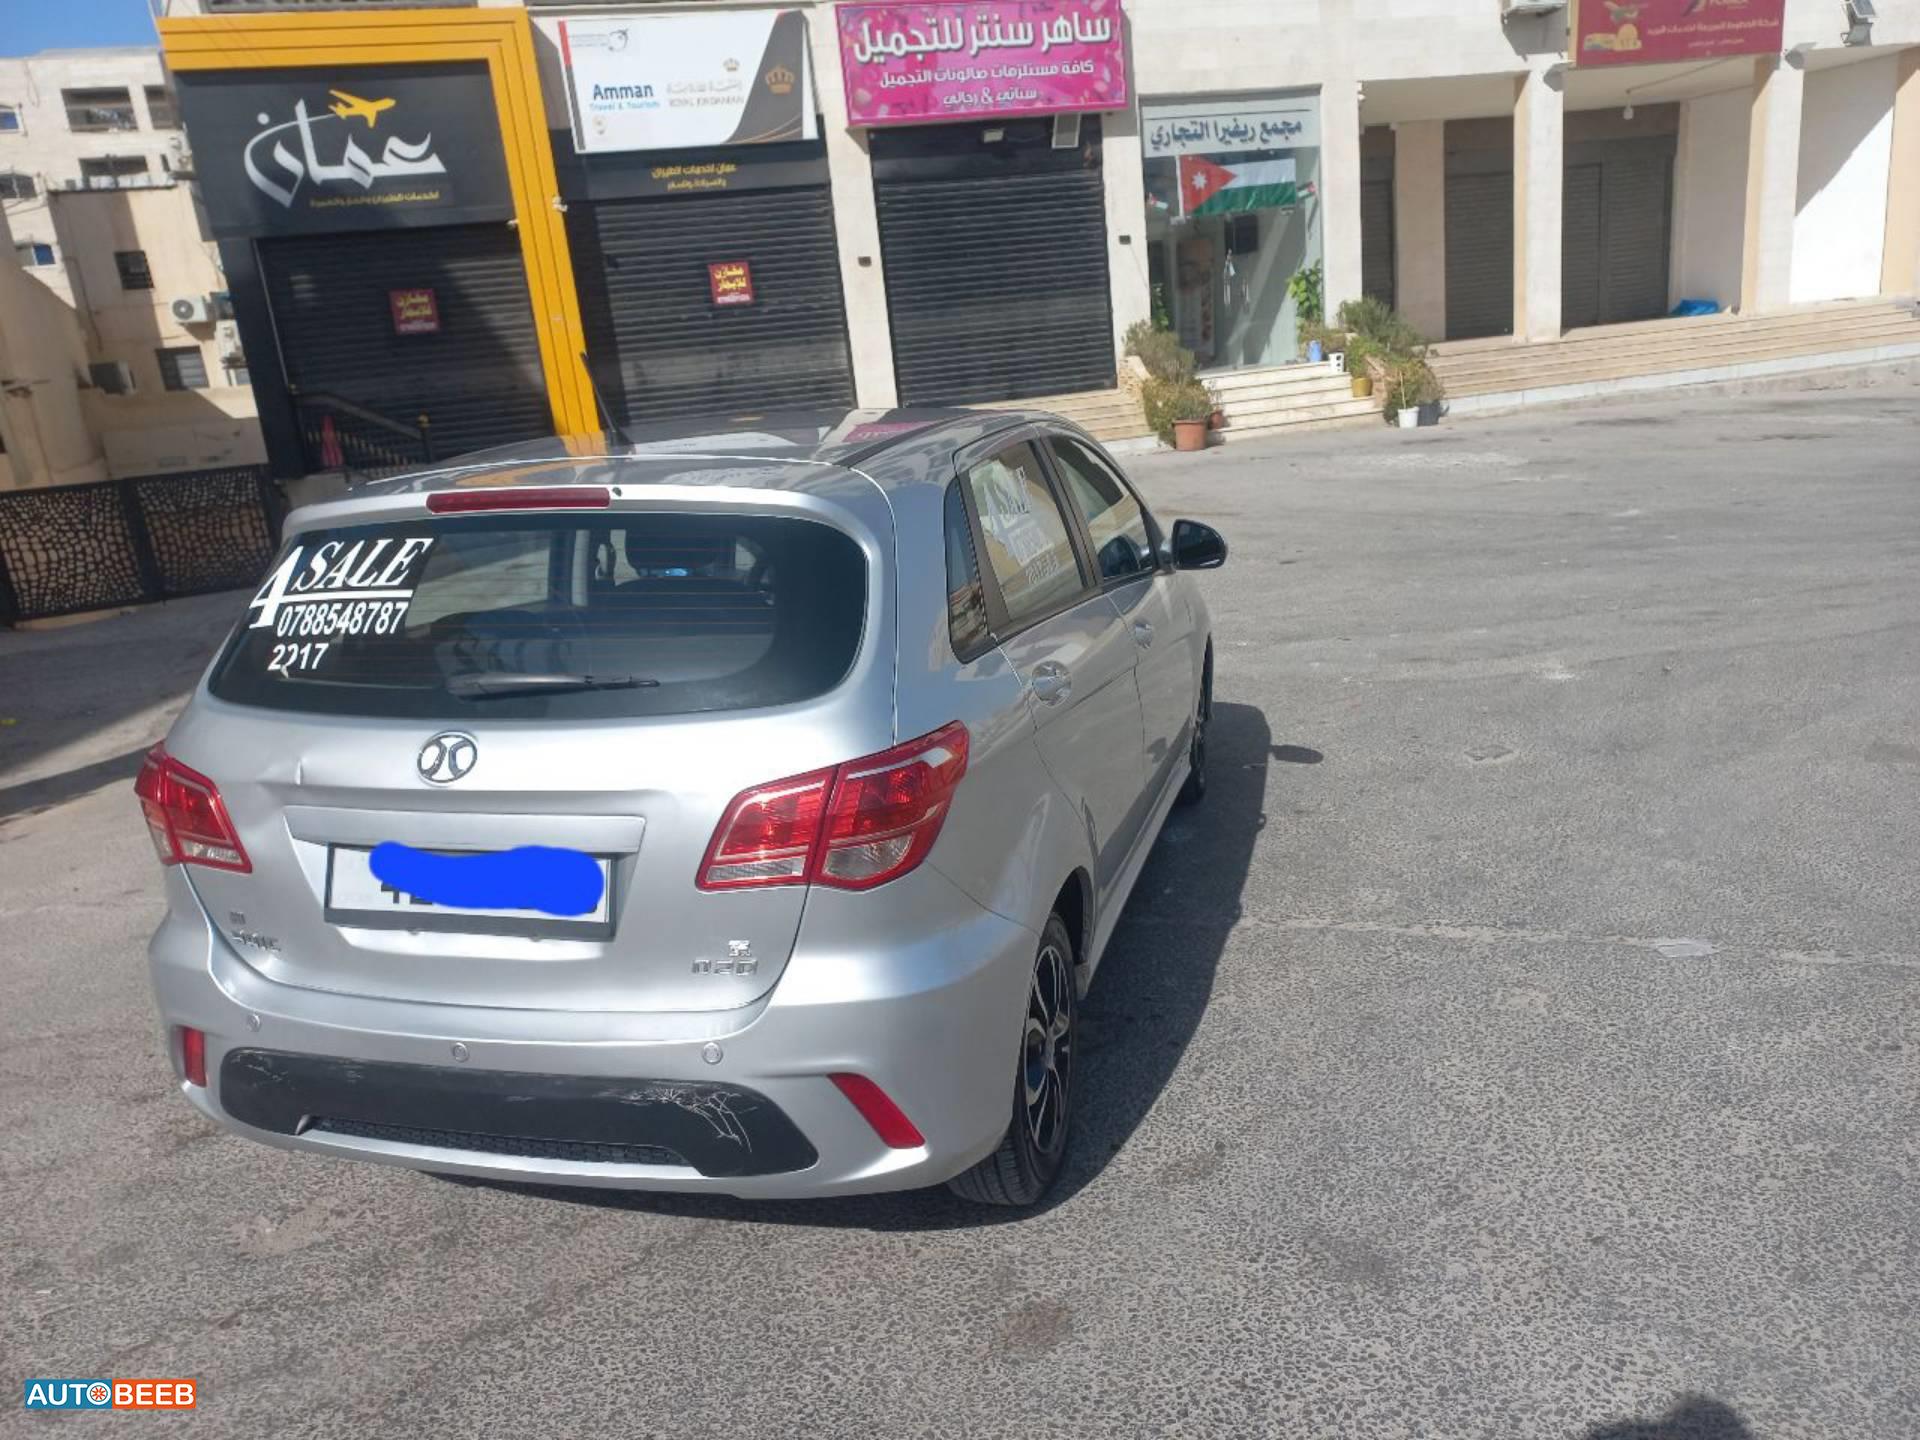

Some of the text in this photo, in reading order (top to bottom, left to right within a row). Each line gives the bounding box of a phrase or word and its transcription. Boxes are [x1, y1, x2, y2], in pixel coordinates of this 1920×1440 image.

[854, 11, 1112, 64] ساهر سنتر للتجميل
[880, 59, 1095, 88] كافة مستلزمات صالونات التجميل
[593, 83, 654, 101] Amman
[981, 87, 994, 104] &
[1151, 117, 1303, 150] مجمع ريفيرا التجاري
[244, 98, 447, 208] عمان
[249, 538, 434, 629] 4 SALE
[277, 601, 409, 638] 0788548787
